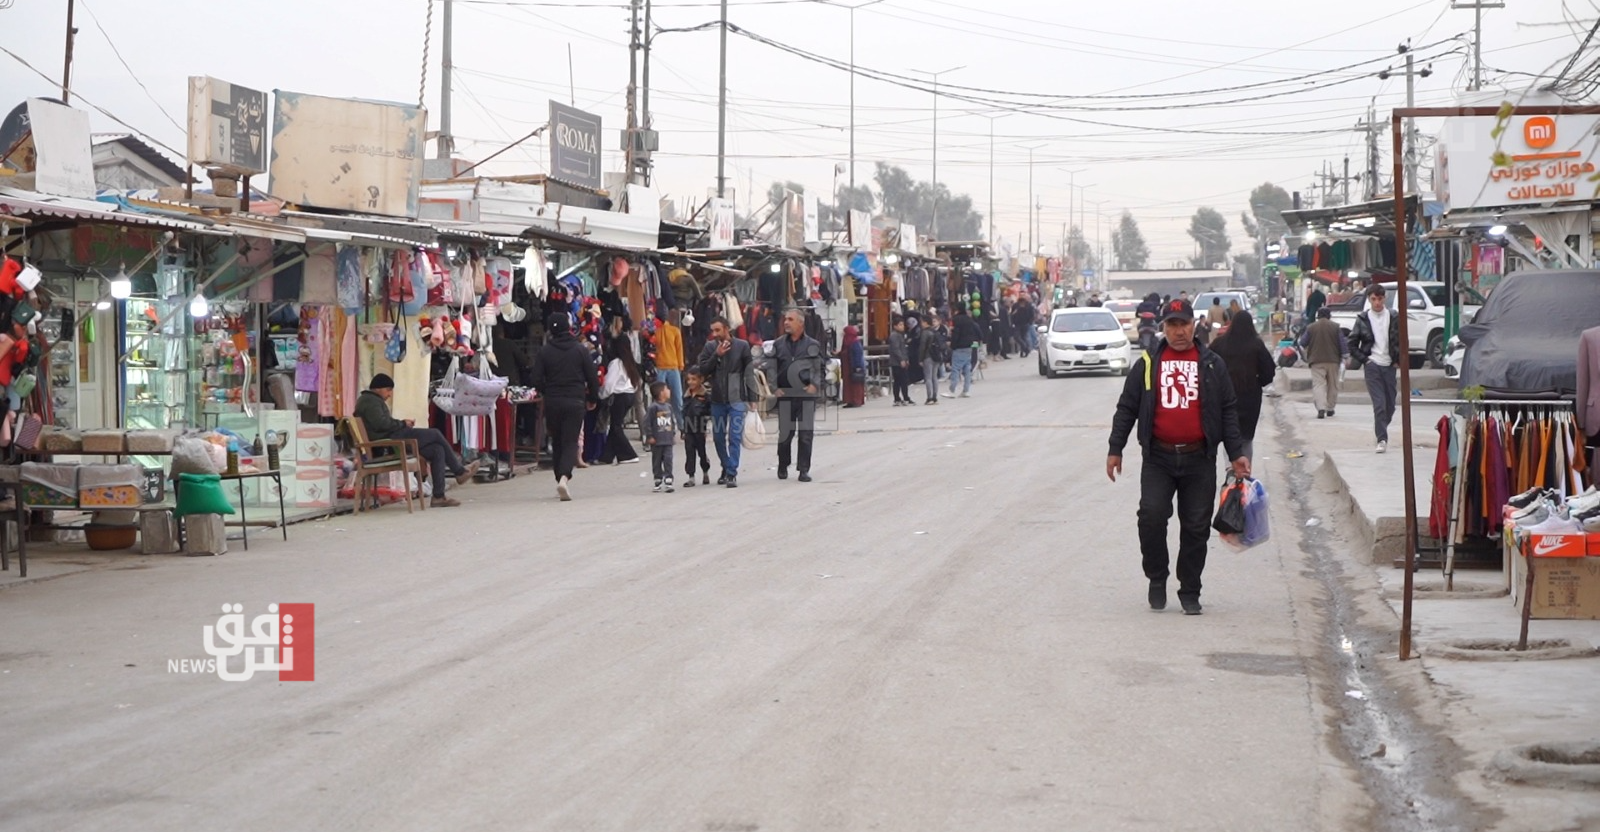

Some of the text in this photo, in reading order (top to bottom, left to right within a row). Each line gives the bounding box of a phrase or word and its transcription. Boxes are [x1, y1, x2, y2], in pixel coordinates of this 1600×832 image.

[557, 122, 598, 155] ROMA
[1545, 160, 1595, 179] هوزان
[1507, 182, 1575, 200] للاتصالات
[1161, 360, 1198, 374] NEVER
[1160, 386, 1199, 409] UP
[1540, 535, 1564, 547] NIKE
